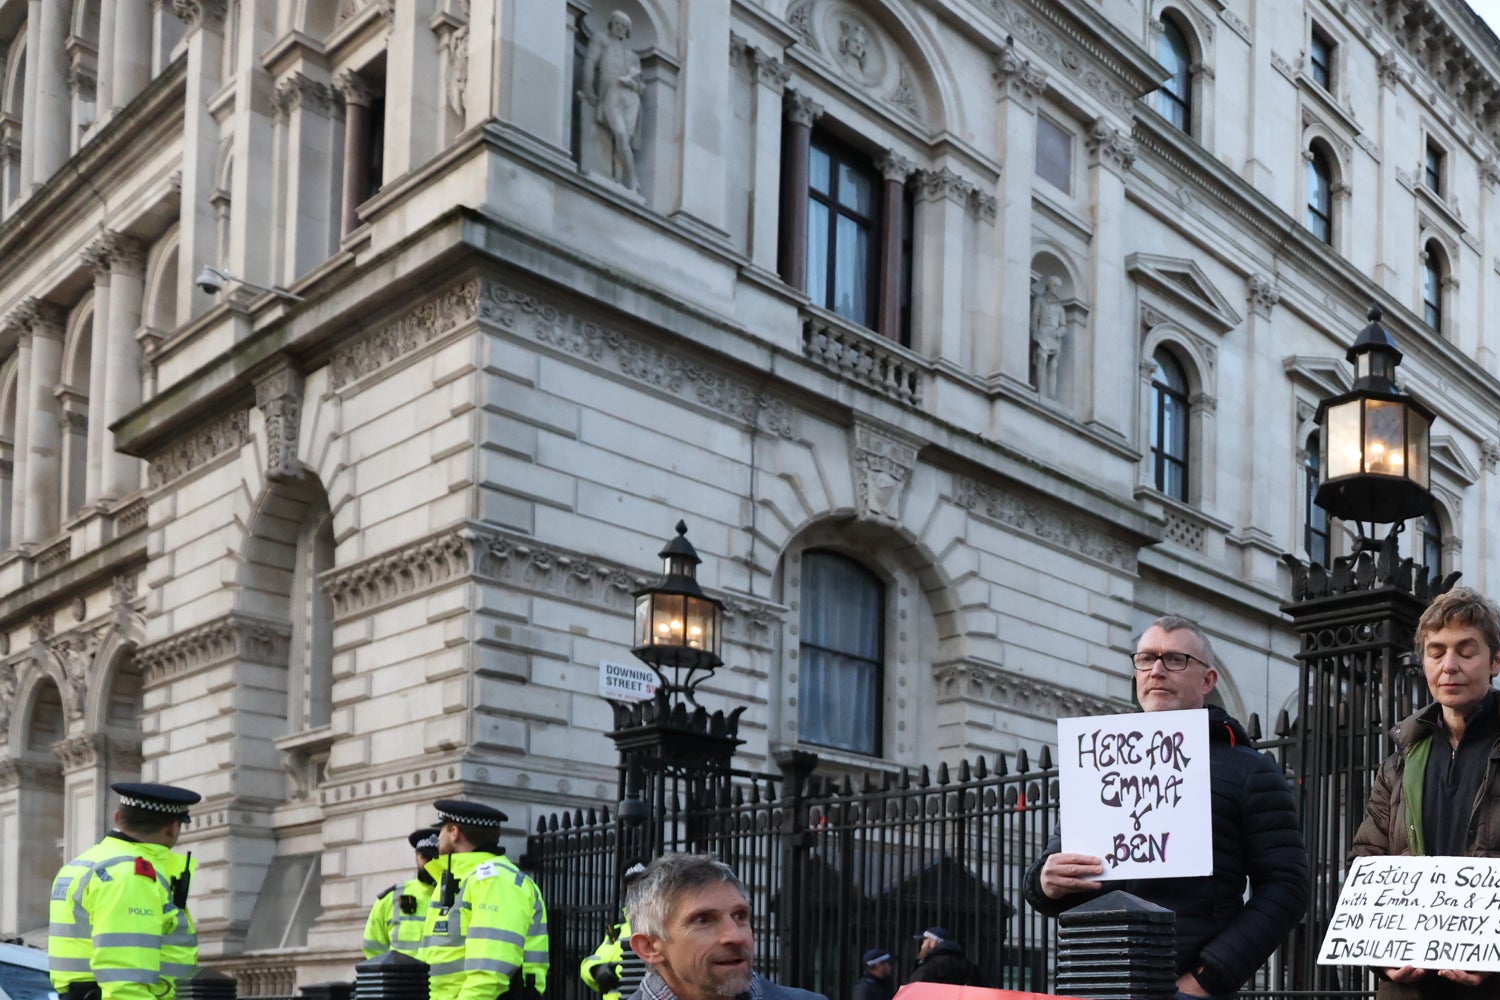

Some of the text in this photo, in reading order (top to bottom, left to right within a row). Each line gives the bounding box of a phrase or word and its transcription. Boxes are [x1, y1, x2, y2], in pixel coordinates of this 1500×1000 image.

[606, 664, 653, 683] DOWNING
[606, 676, 642, 692] STREET
[1078, 729, 1143, 771] HERE
[1101, 772, 1183, 809] EMMA
[1105, 832, 1170, 869] BEN
[1351, 861, 1424, 896] Fasting
[1430, 864, 1448, 885] in
[1341, 889, 1367, 907] with
[1430, 890, 1459, 908] Ben
[1463, 891, 1484, 908] &
[128, 907, 154, 916] POLIC
[1332, 913, 1365, 931] END
[1369, 912, 1408, 931] FUEL
[1325, 937, 1417, 961] INSULATE
